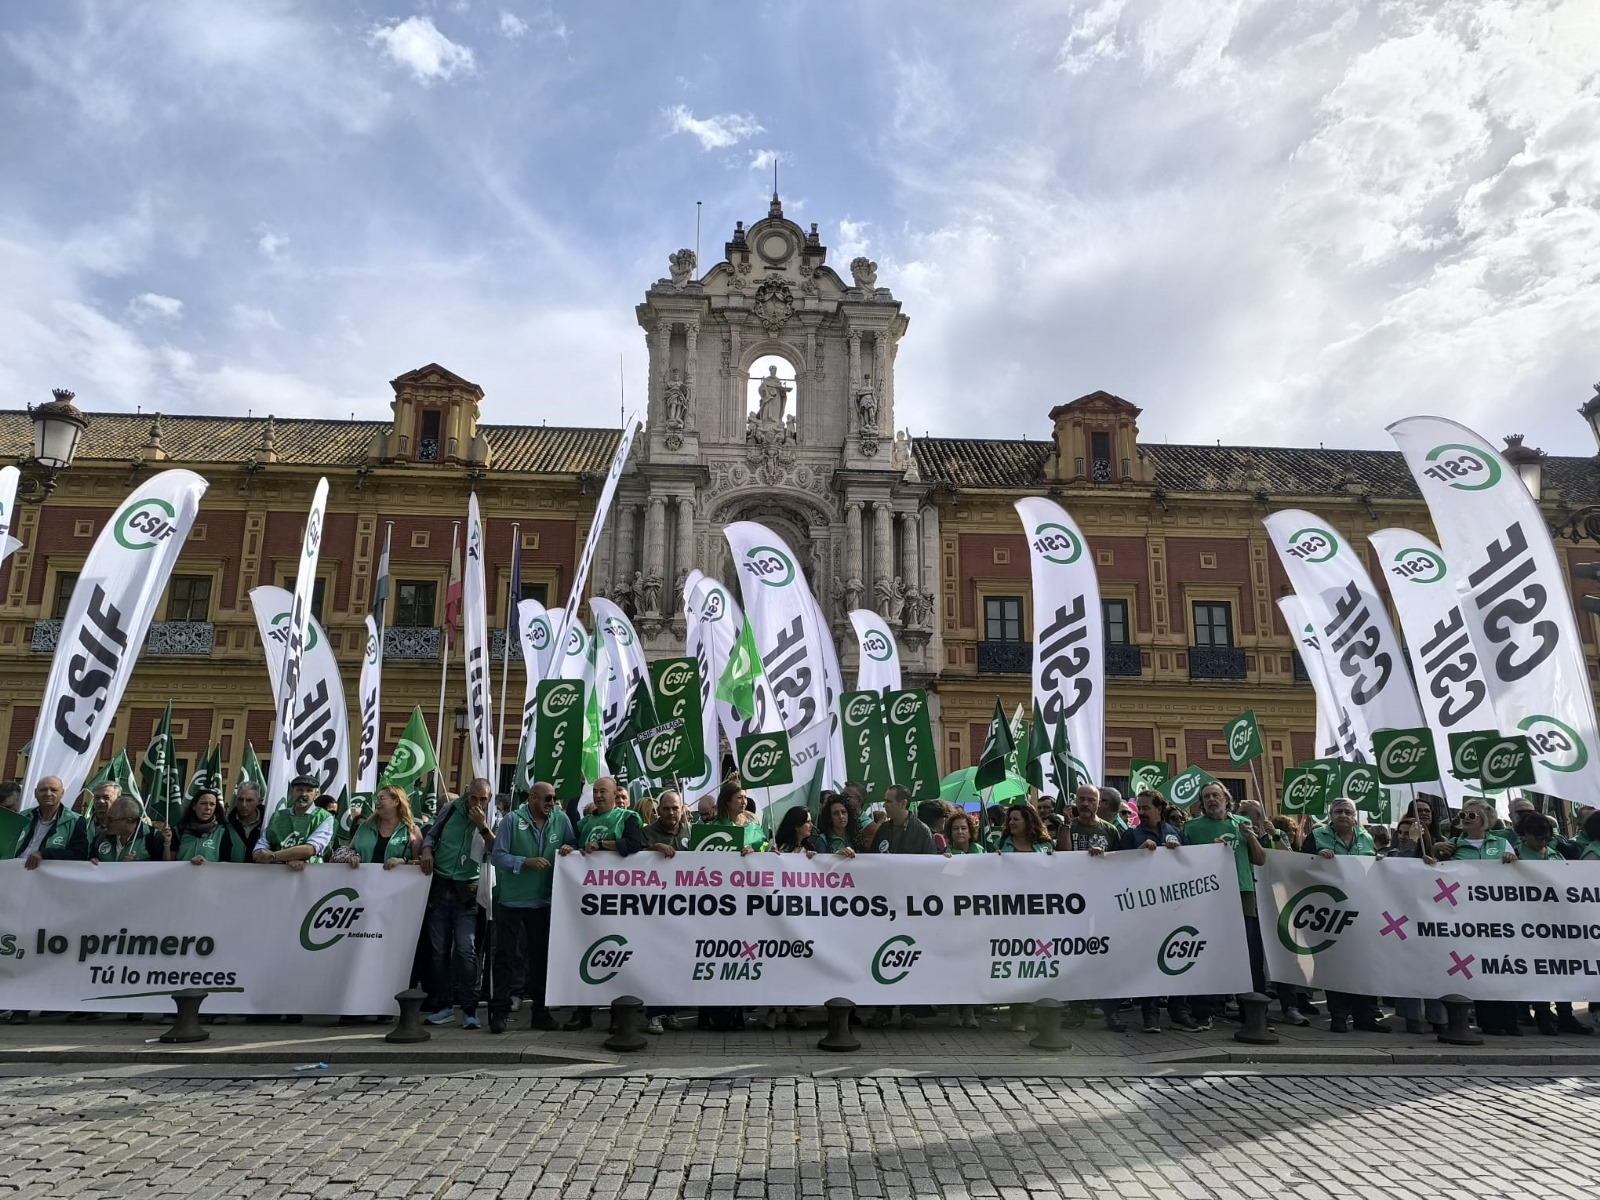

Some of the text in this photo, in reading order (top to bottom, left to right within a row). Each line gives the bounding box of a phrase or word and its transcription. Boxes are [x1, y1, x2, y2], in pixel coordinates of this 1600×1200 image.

[129, 511, 177, 541] CSIF
[55, 583, 128, 755] CSIF
[665, 671, 694, 685] CSIF
[550, 694, 579, 706] CSIF
[851, 703, 876, 716] CSIF
[897, 701, 922, 714] CSIF
[637, 730, 654, 741] CSIF
[1233, 726, 1253, 749] CSIF
[653, 736, 682, 759] CSIF
[1389, 747, 1428, 764] CSIF
[750, 751, 783, 768] CSIF
[1490, 752, 1525, 770] CSIF
[1177, 774, 1201, 796] CSIF
[1291, 785, 1321, 798] CSIF
[1348, 778, 1375, 793] CSIF
[582, 867, 855, 890] AHORA, MÁS QUE NUNCA
[1114, 874, 1220, 912] TÚ LO MERECES
[1468, 885, 1560, 903] ¡SUBIDA
[580, 889, 1086, 922] SERVICIOS PÚBLICOS, LO PRIMERO
[313, 906, 365, 929] CSIF
[1292, 904, 1359, 935] CSIF
[1417, 921, 1600, 940] MEJORES CONDIC
[36, 928, 69, 955] lo
[78, 928, 215, 962] primero
[1166, 940, 1207, 958] CSIF
[590, 949, 633, 968] CSIF
[881, 949, 922, 968] CSIF
[990, 955, 1060, 979] ES MÁS
[1481, 954, 1528, 975] MÁS
[89, 965, 237, 986] Tú lo mereces
[692, 957, 763, 981] ES MÁS
